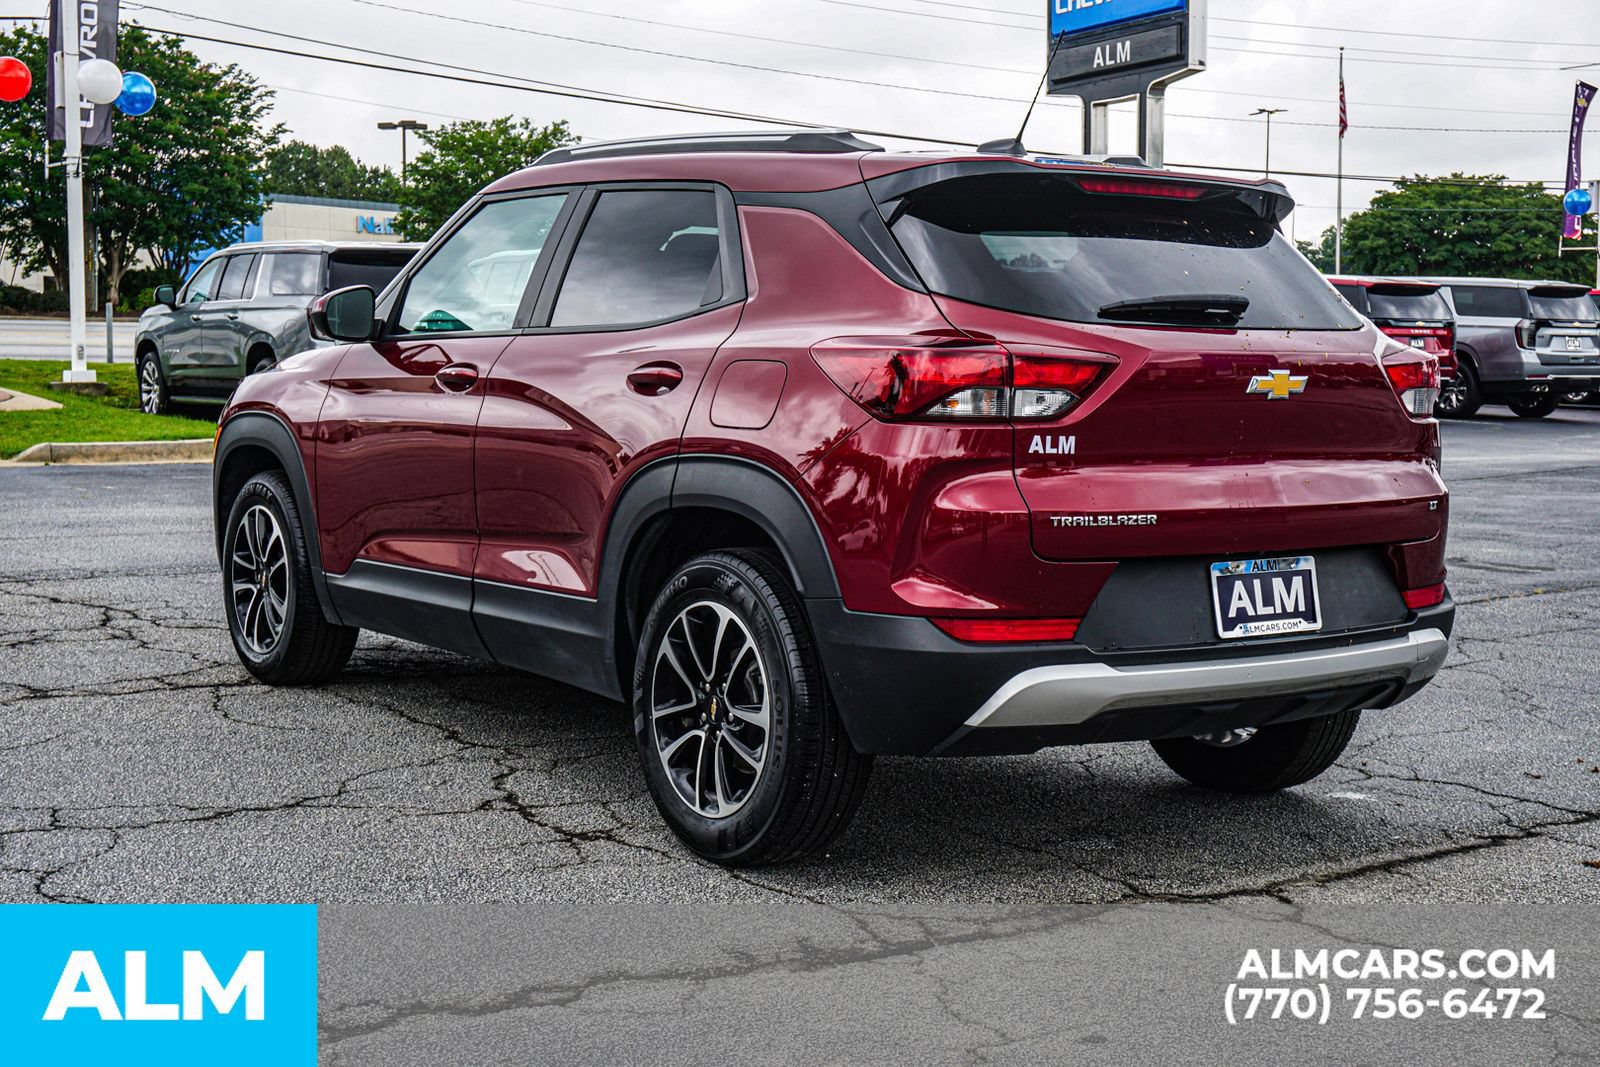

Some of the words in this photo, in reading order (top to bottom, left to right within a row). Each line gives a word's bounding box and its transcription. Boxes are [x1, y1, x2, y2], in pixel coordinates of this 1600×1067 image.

[1093, 40, 1131, 68] ALM
[1411, 339, 1425, 348] ALM
[1028, 435, 1076, 454] ALM
[1050, 514, 1157, 527] TRAILBLAZER
[1251, 560, 1278, 572] ALM
[1228, 576, 1306, 618] ALM
[1244, 622, 1299, 634] ALMCARS.COM
